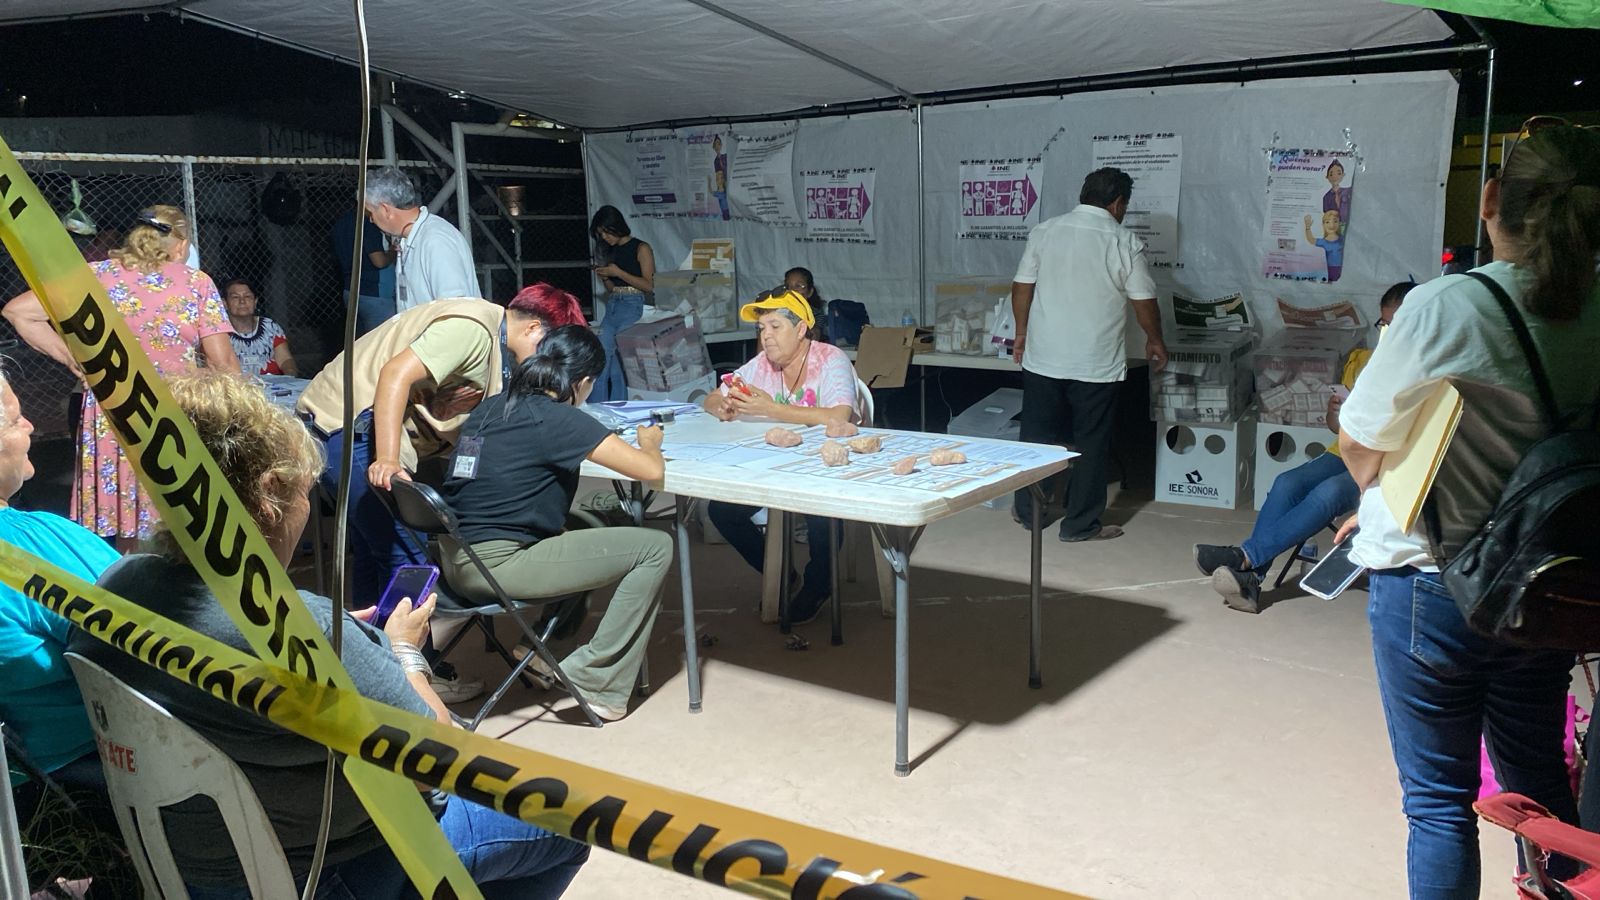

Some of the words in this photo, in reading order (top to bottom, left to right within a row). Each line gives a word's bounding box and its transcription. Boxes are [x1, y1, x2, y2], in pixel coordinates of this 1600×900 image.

[1278, 163, 1301, 171] pueden
[1302, 164, 1326, 172] votar?
[1168, 352, 1221, 364] NTAMIENTO
[1169, 483, 1184, 493] IEE
[1187, 485, 1219, 496] SONORA
[60, 292, 340, 714] PRECAUCIÓ
[360, 723, 976, 900] PRECAUCIÓ
